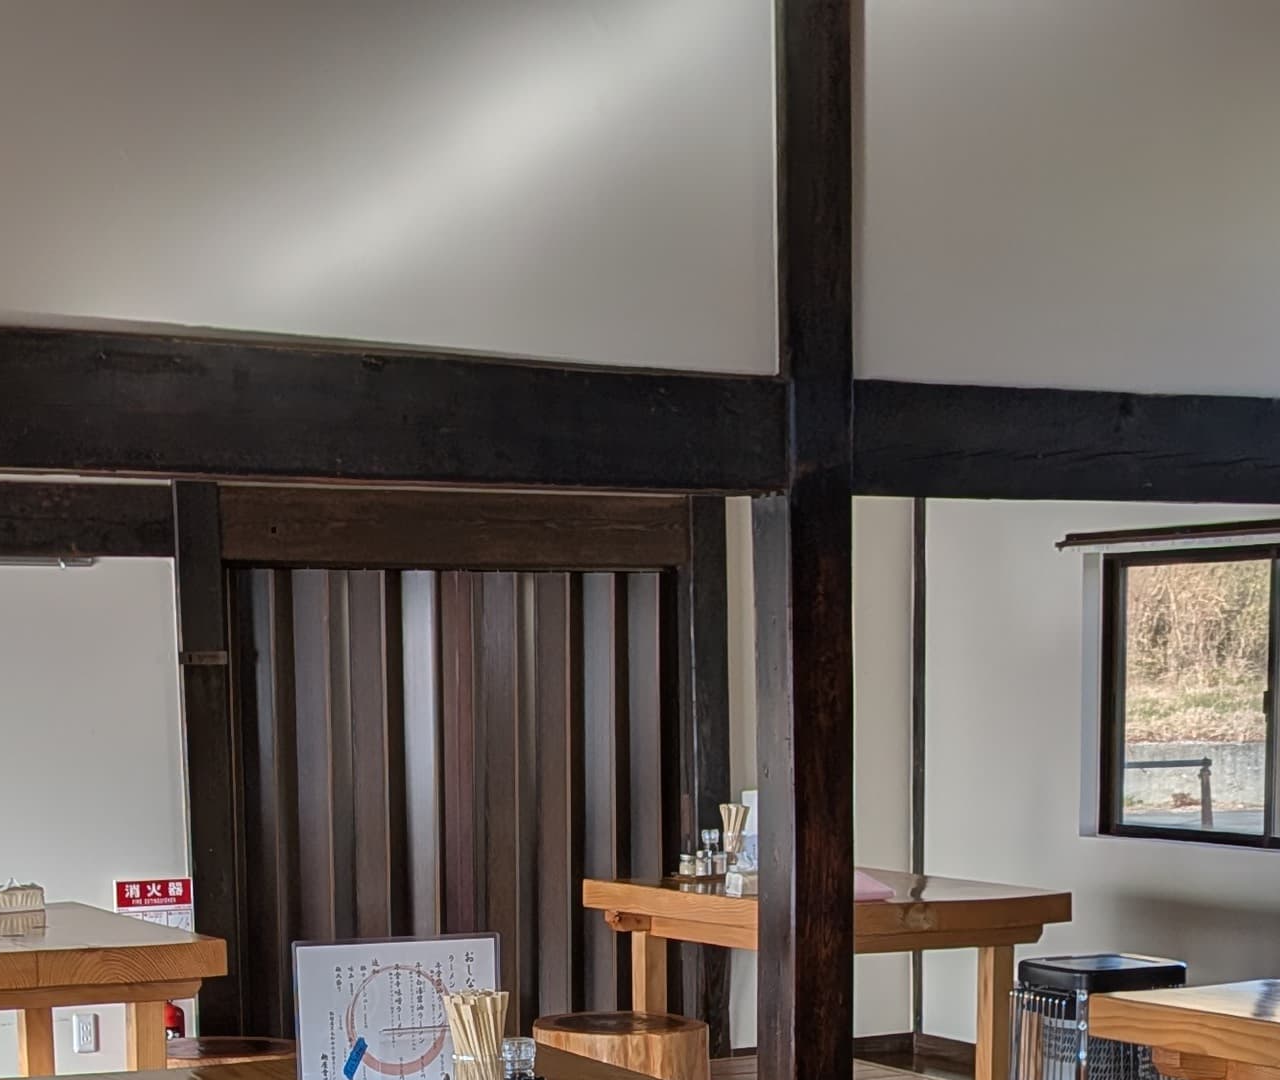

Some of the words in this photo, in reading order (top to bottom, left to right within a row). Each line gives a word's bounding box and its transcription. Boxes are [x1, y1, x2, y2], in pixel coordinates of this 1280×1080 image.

[124, 881, 183, 898] 消火器
[448, 954, 456, 988] ラーメン
[464, 951, 475, 989] おしな
